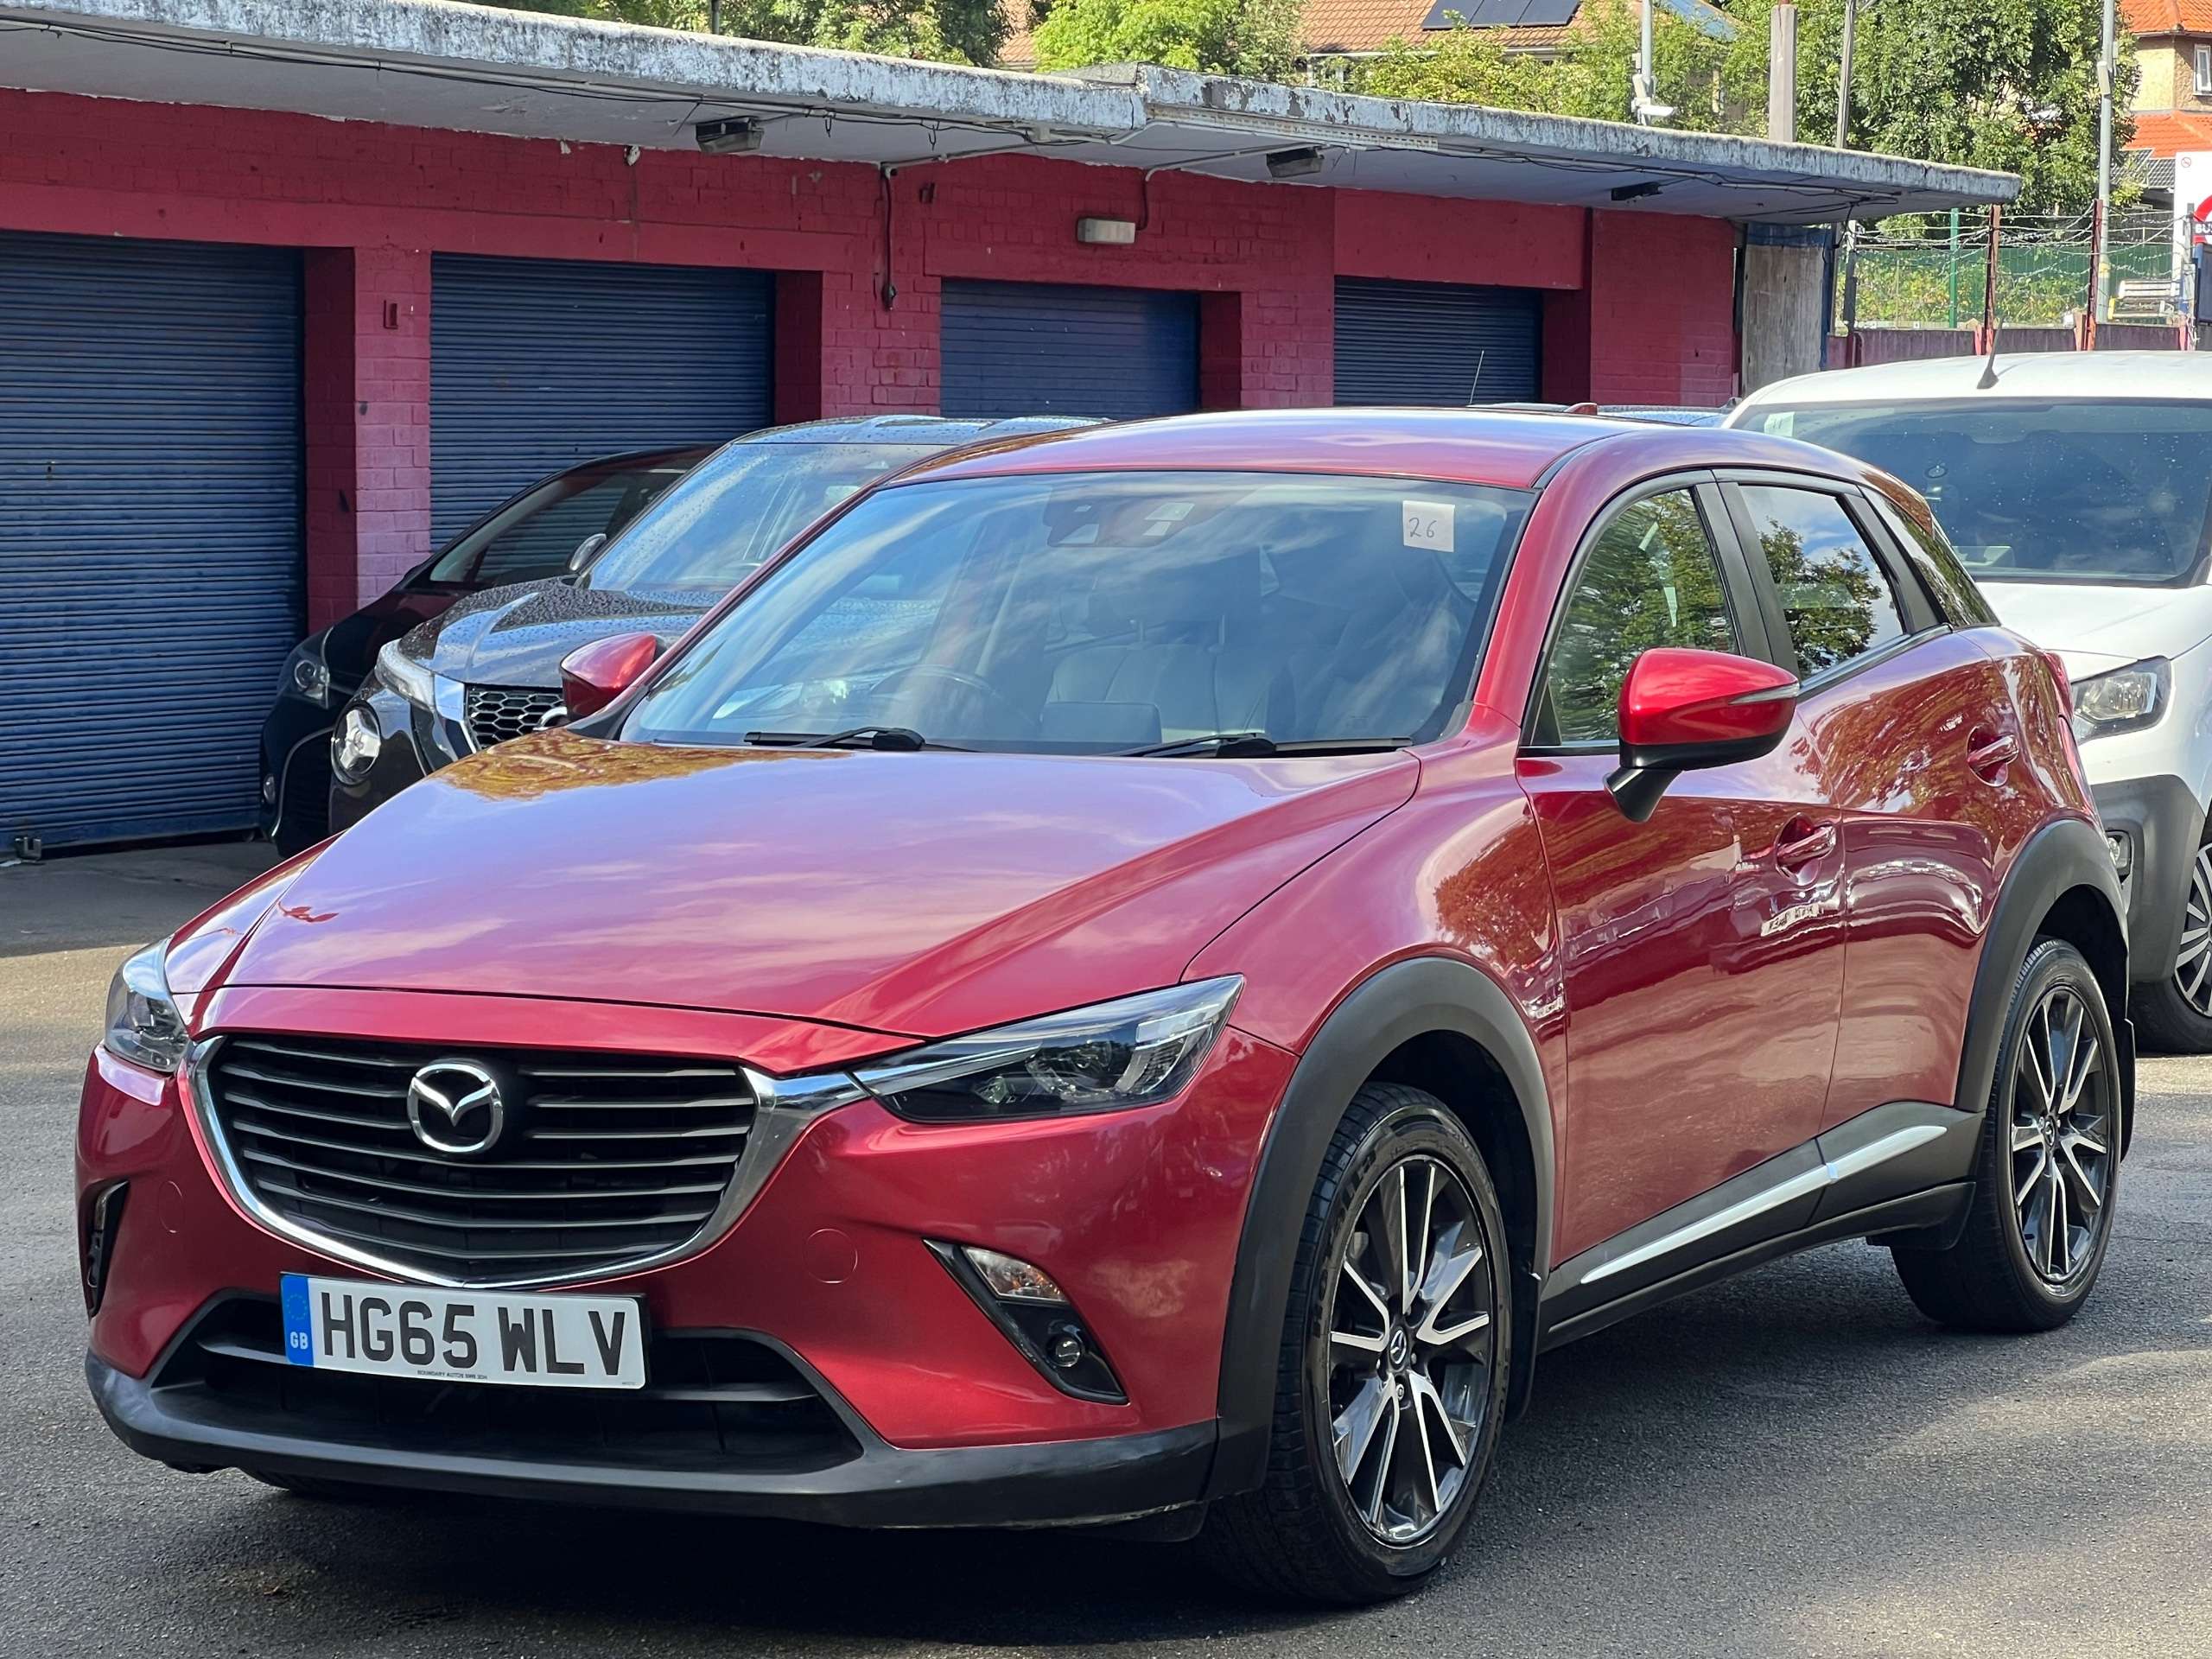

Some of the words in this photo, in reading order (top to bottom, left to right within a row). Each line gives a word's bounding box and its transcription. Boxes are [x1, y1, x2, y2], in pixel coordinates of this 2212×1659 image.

[2196, 223, 2212, 234] BU
[1408, 517, 1437, 538] 26
[321, 1292, 478, 1369] HG65
[289, 1332, 308, 1350] GB
